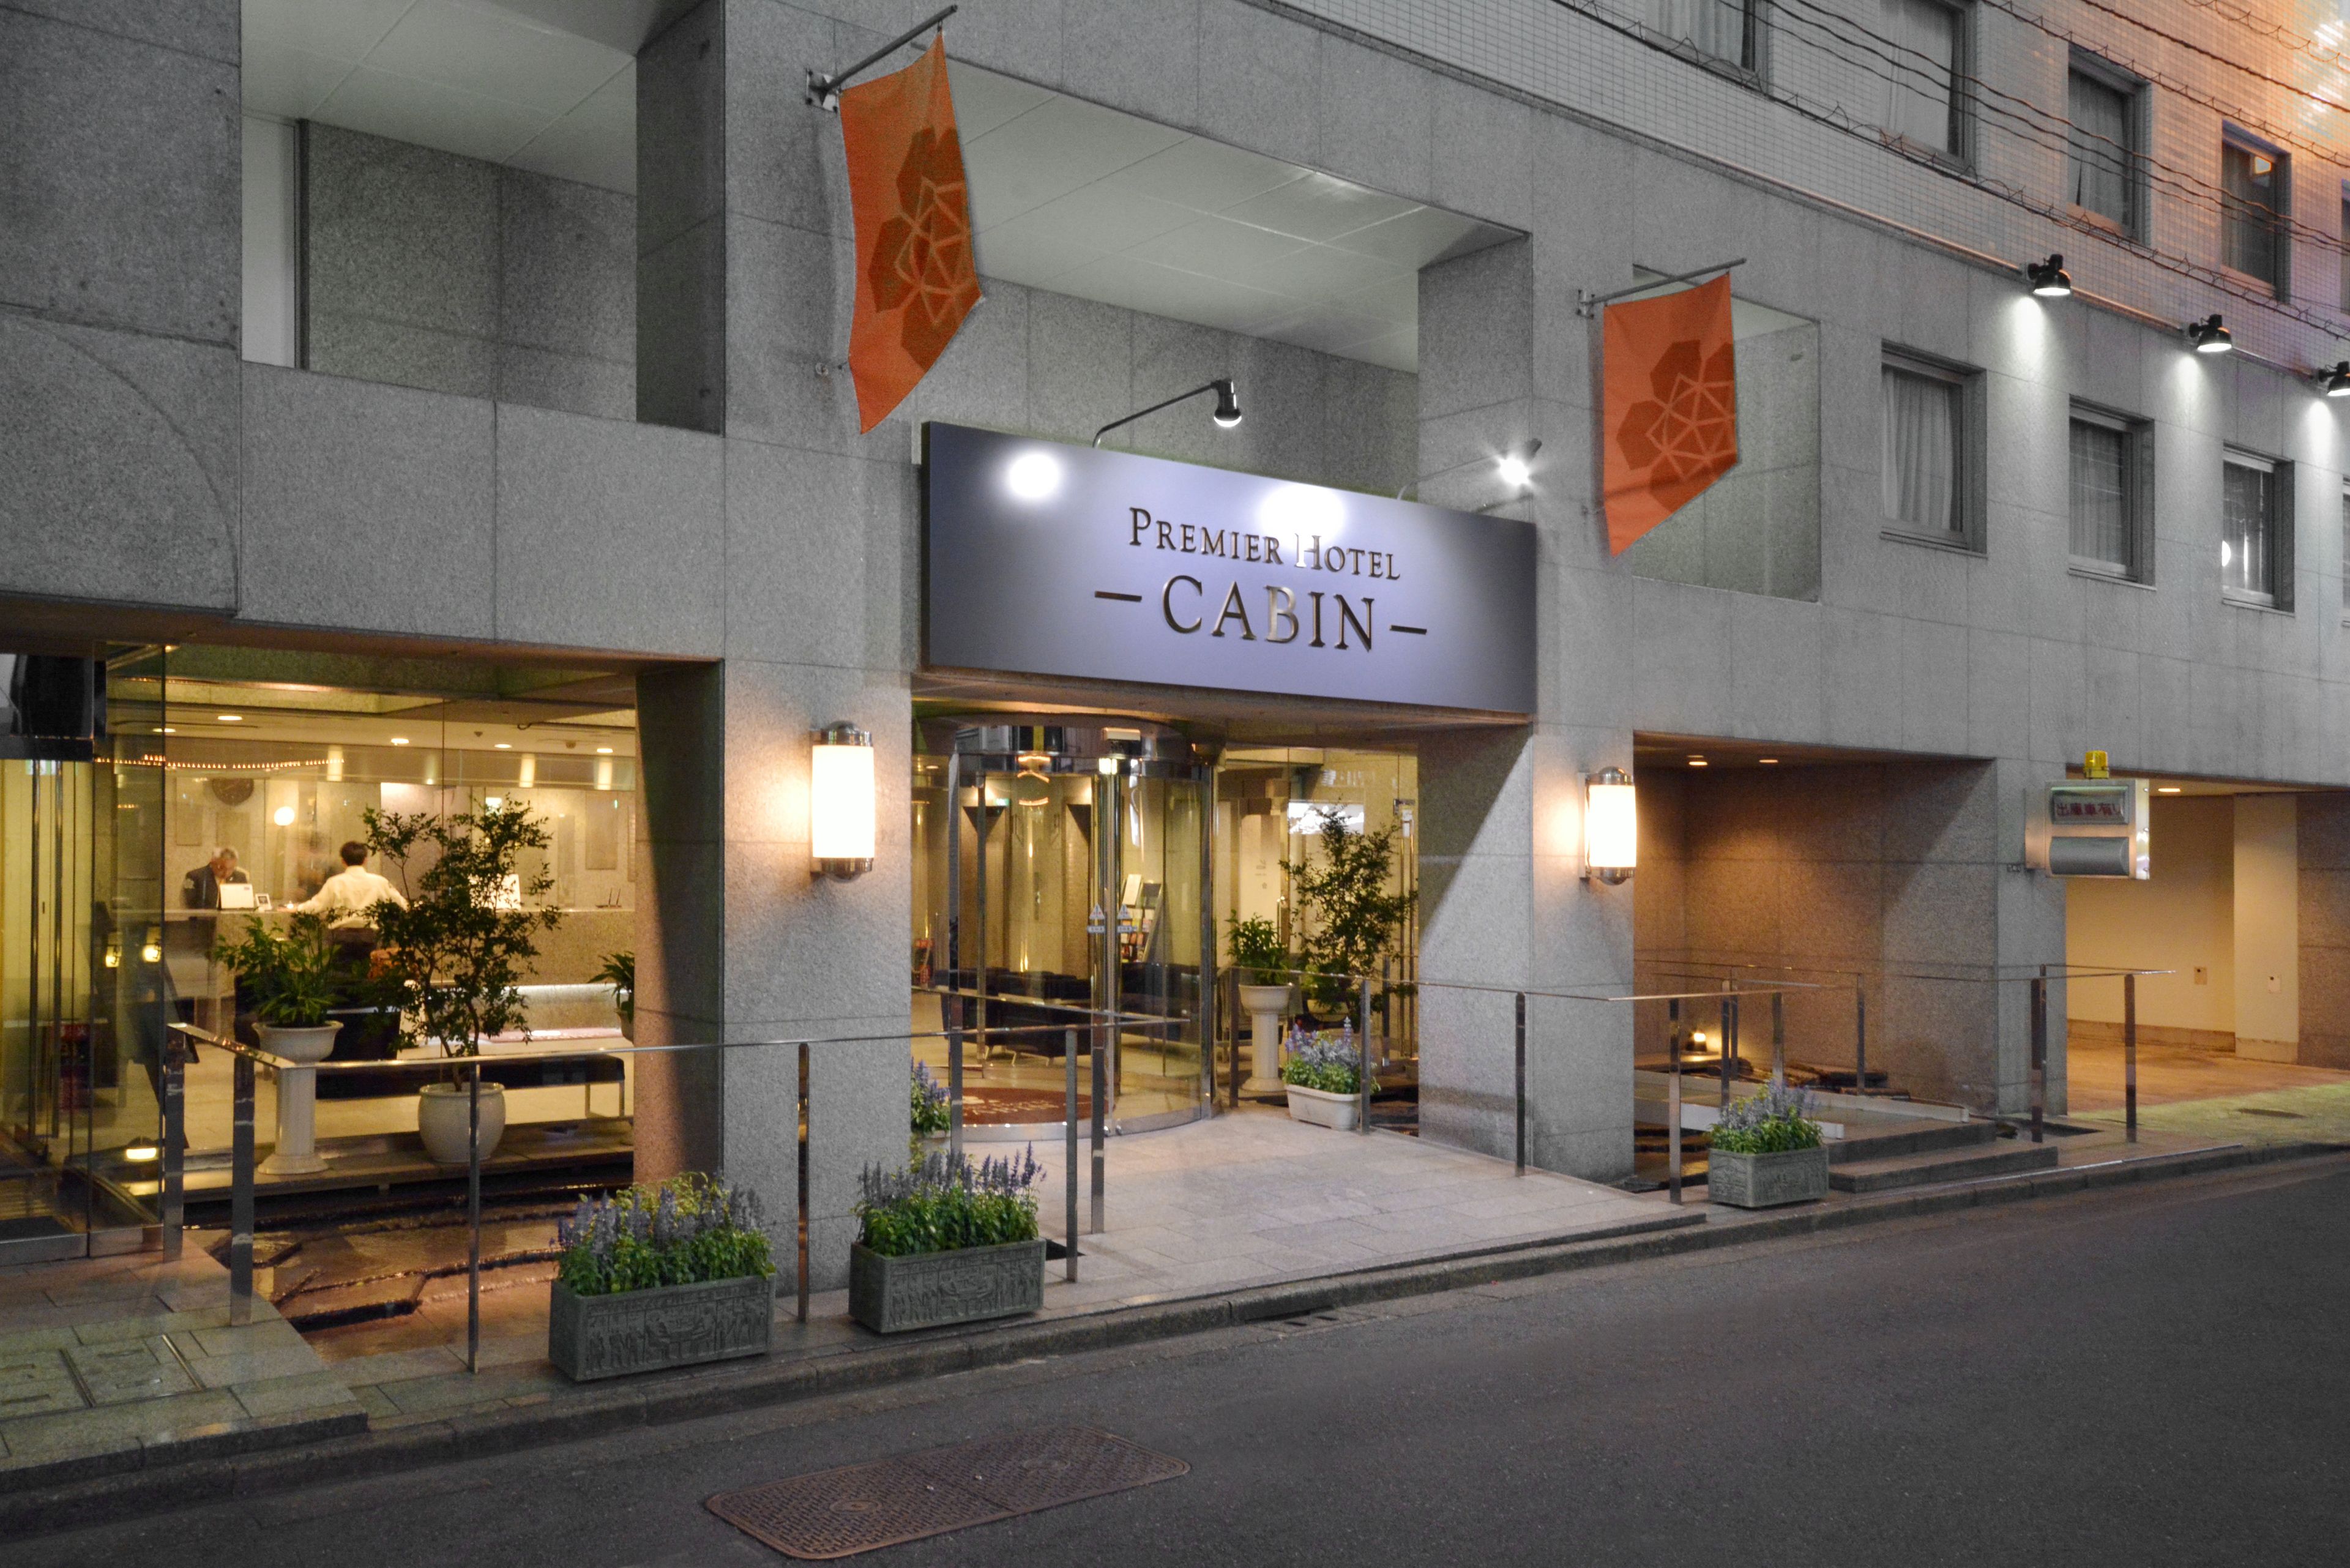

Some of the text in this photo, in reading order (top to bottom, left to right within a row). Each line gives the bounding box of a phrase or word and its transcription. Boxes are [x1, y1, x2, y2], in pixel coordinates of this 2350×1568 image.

[1129, 507, 1400, 580] PREMIER HOTEL
[1162, 575, 1375, 652] CABIN
